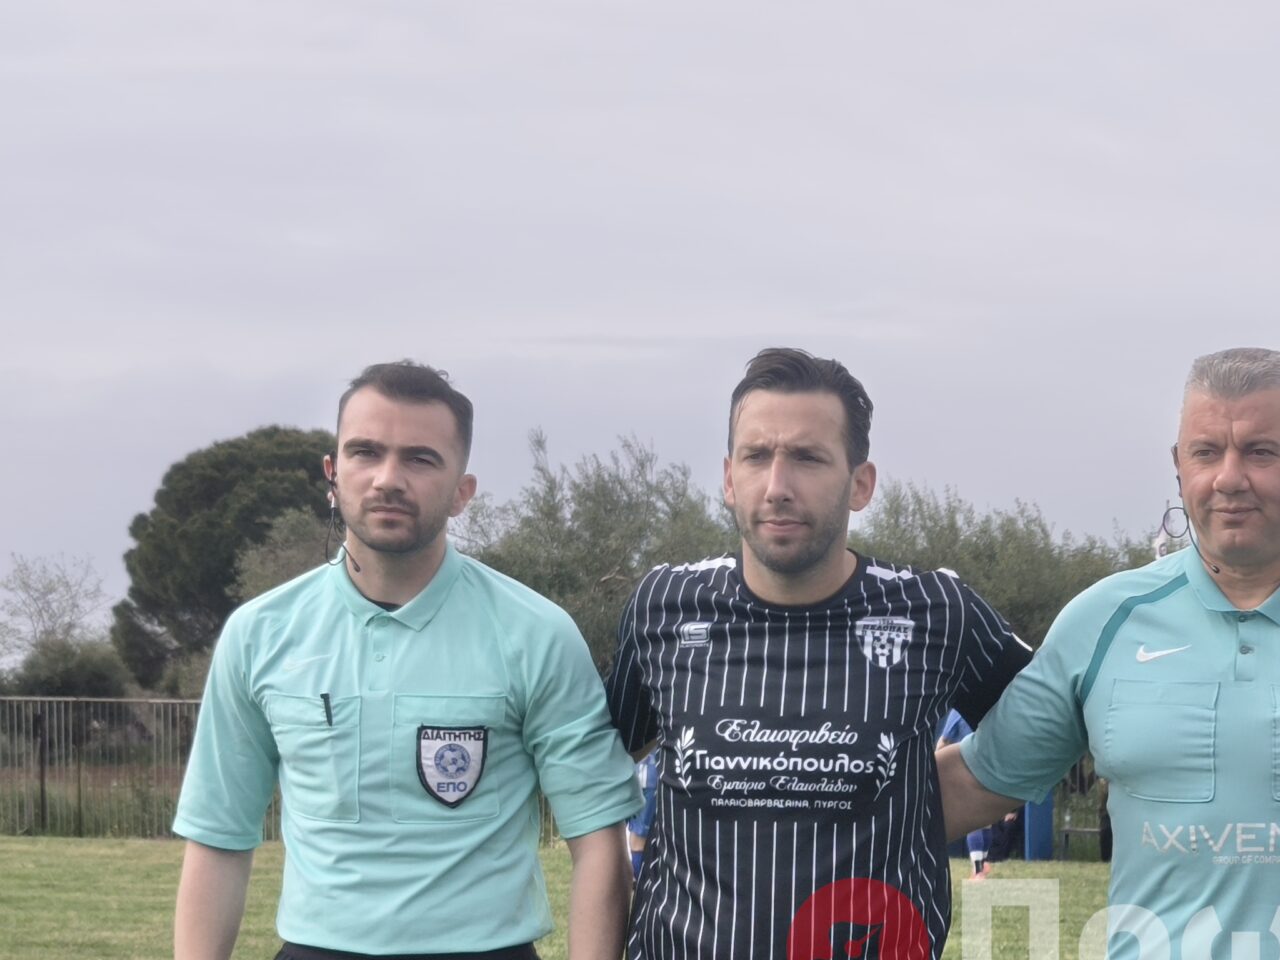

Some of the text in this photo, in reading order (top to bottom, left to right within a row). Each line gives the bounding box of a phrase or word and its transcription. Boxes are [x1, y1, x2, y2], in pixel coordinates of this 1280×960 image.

[716, 718, 858, 750] Ελαιοτριβείο
[695, 750, 875, 773] Γιαννικόπουλος
[437, 782, 467, 793] ΕΠΟ
[707, 775, 766, 795] Εμπόριο
[814, 800, 852, 810] ΠΥΡΓΟΣ
